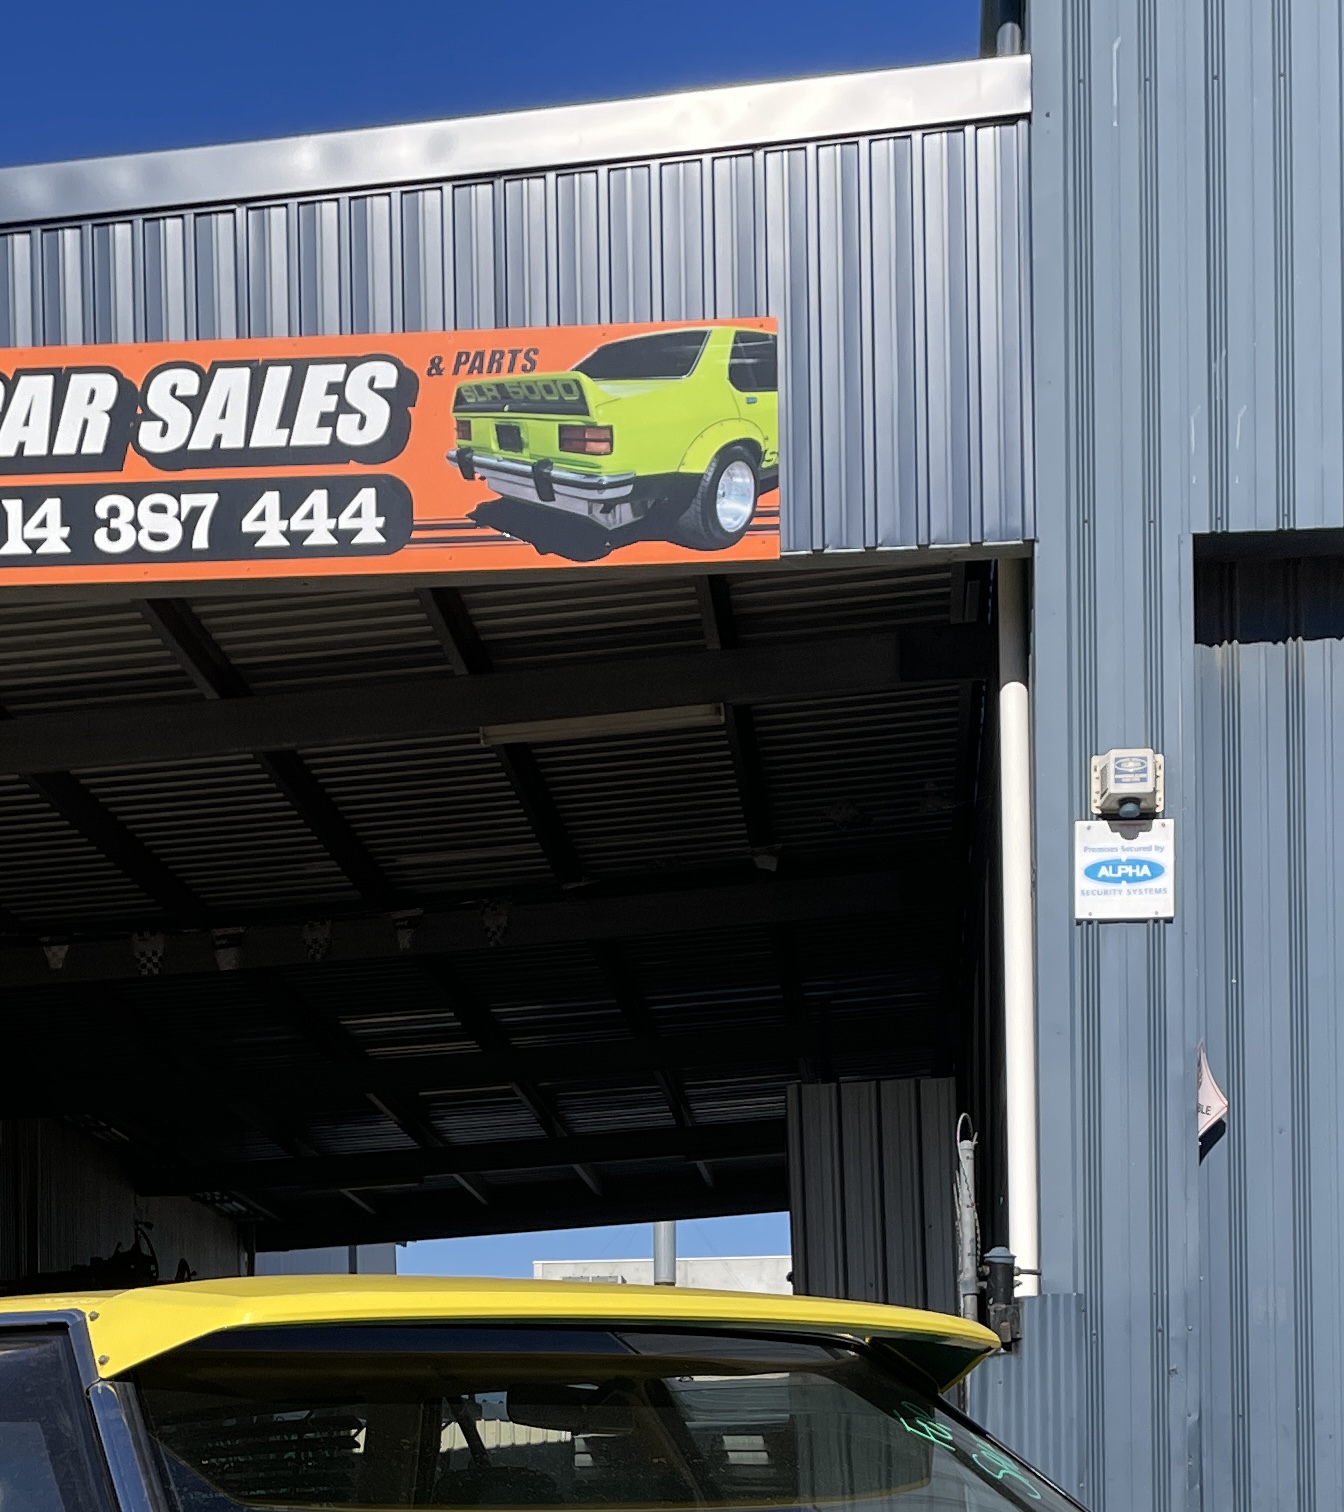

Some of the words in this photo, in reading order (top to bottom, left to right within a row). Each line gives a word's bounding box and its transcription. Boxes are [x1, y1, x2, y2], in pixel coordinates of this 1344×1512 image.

[426, 355, 445, 377] &
[452, 347, 539, 376] PARTS
[506, 379, 581, 401] 5000
[137, 360, 399, 455] SALES
[93, 491, 220, 555] 387
[241, 487, 386, 549] 444
[1097, 864, 1152, 878] ALPHA
[1126, 888, 1168, 896] SYSTEMS
